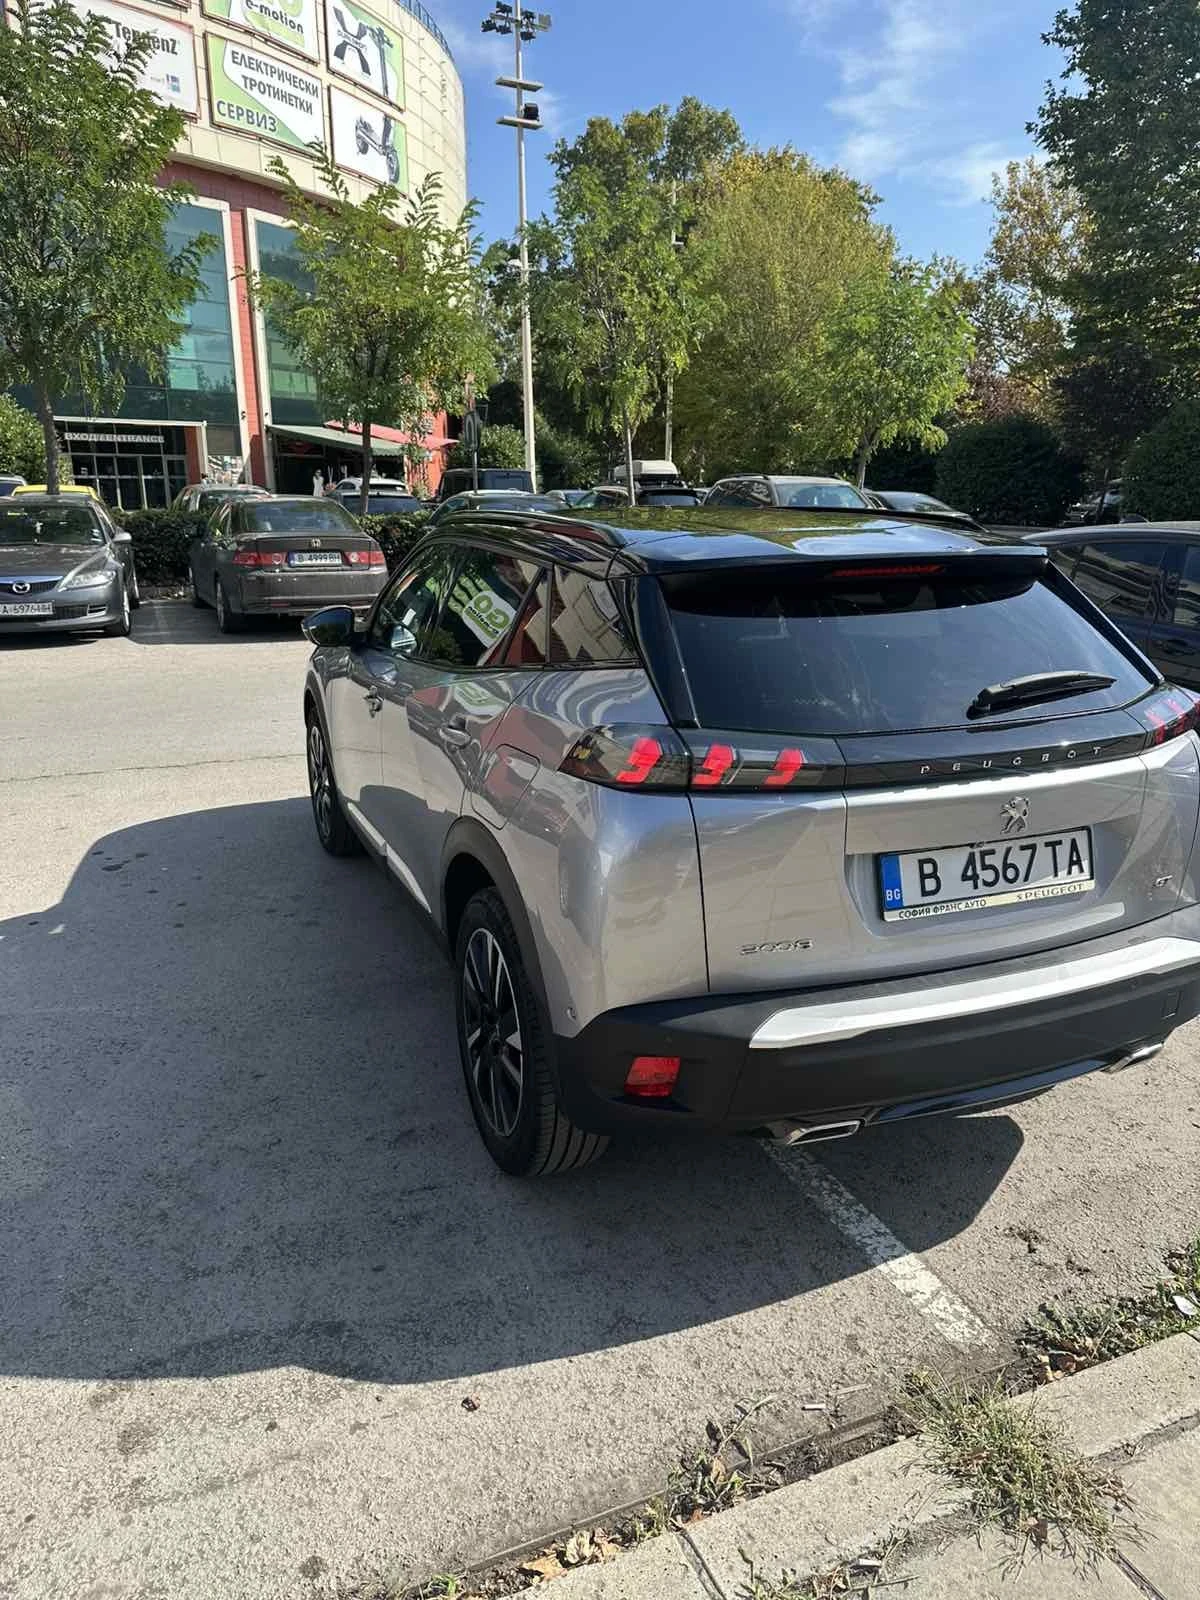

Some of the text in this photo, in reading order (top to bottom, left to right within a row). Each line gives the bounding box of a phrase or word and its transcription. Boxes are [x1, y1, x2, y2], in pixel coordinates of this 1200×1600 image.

[246, 0, 304, 34] e-motion
[231, 49, 319, 98] ЕЛЕКТРИЧЕСКИ
[241, 74, 313, 116] ТРОТИНЕТКИ
[216, 100, 277, 133] СЕРВИЗ
[919, 746, 1102, 775] PEUGEOT
[916, 838, 1085, 898] B 4567 TA
[885, 888, 901, 901] BG
[1024, 883, 1085, 900] PEUGEOT
[898, 899, 987, 919] СОФИЯ ФРАНС АУТО
